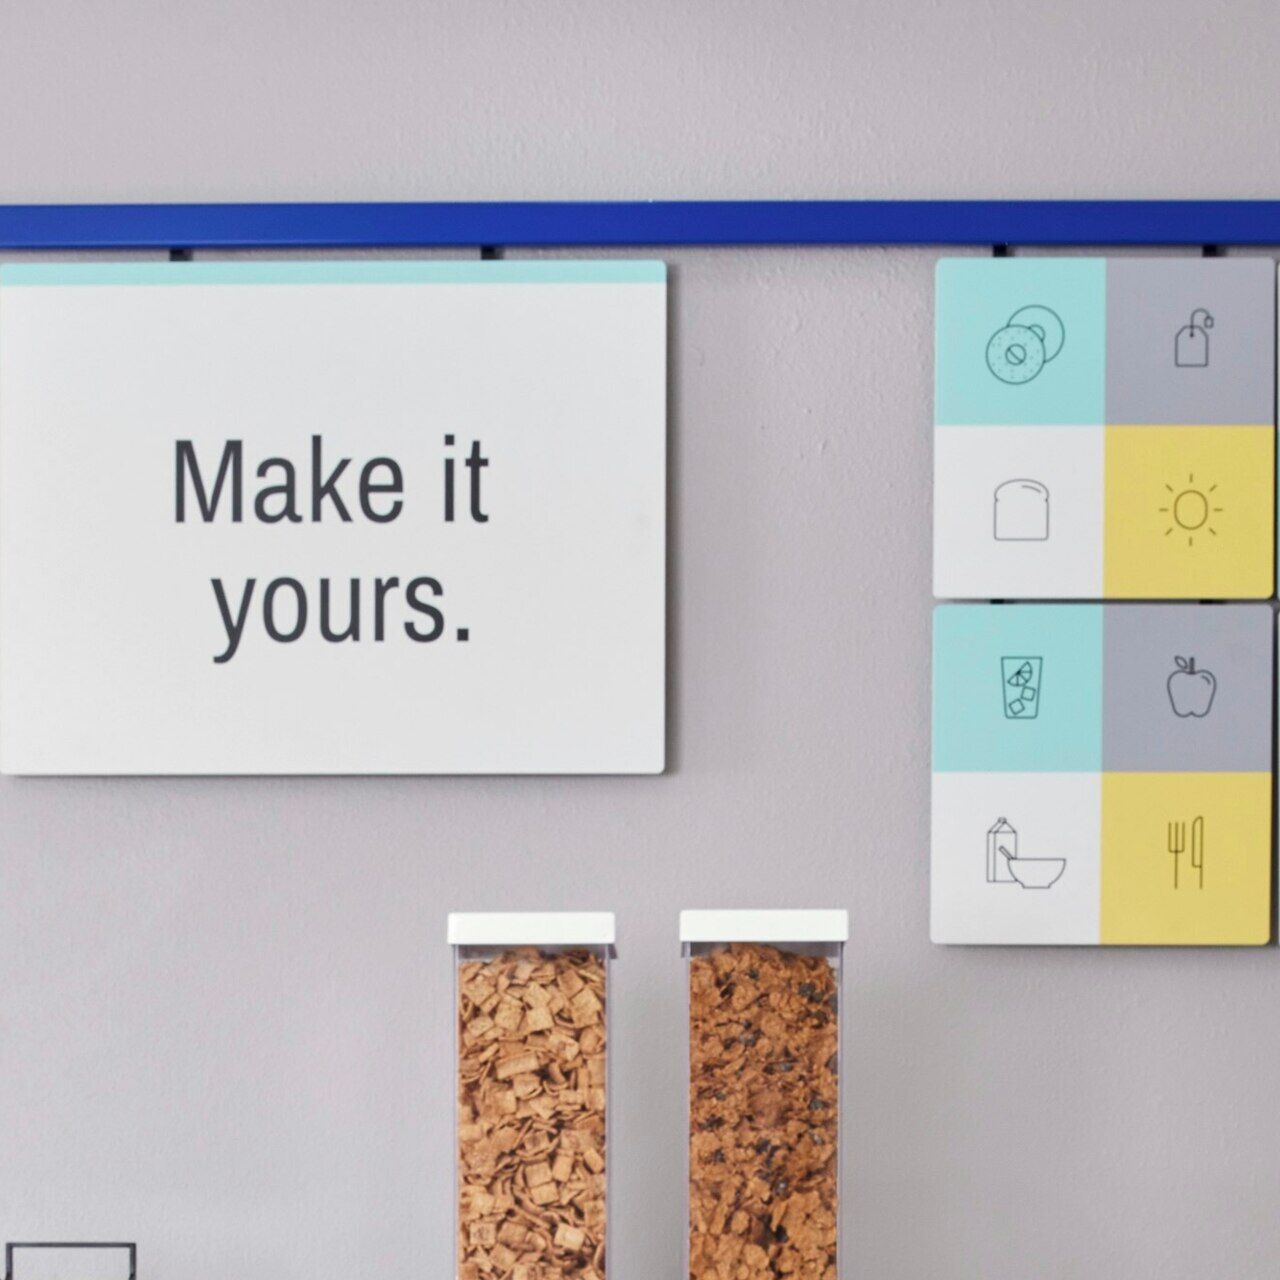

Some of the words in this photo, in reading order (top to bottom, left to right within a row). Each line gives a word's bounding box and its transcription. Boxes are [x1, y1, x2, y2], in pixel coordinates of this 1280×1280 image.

[173, 434, 405, 524] Make
[443, 434, 490, 524] it
[210, 575, 471, 664] yours.
